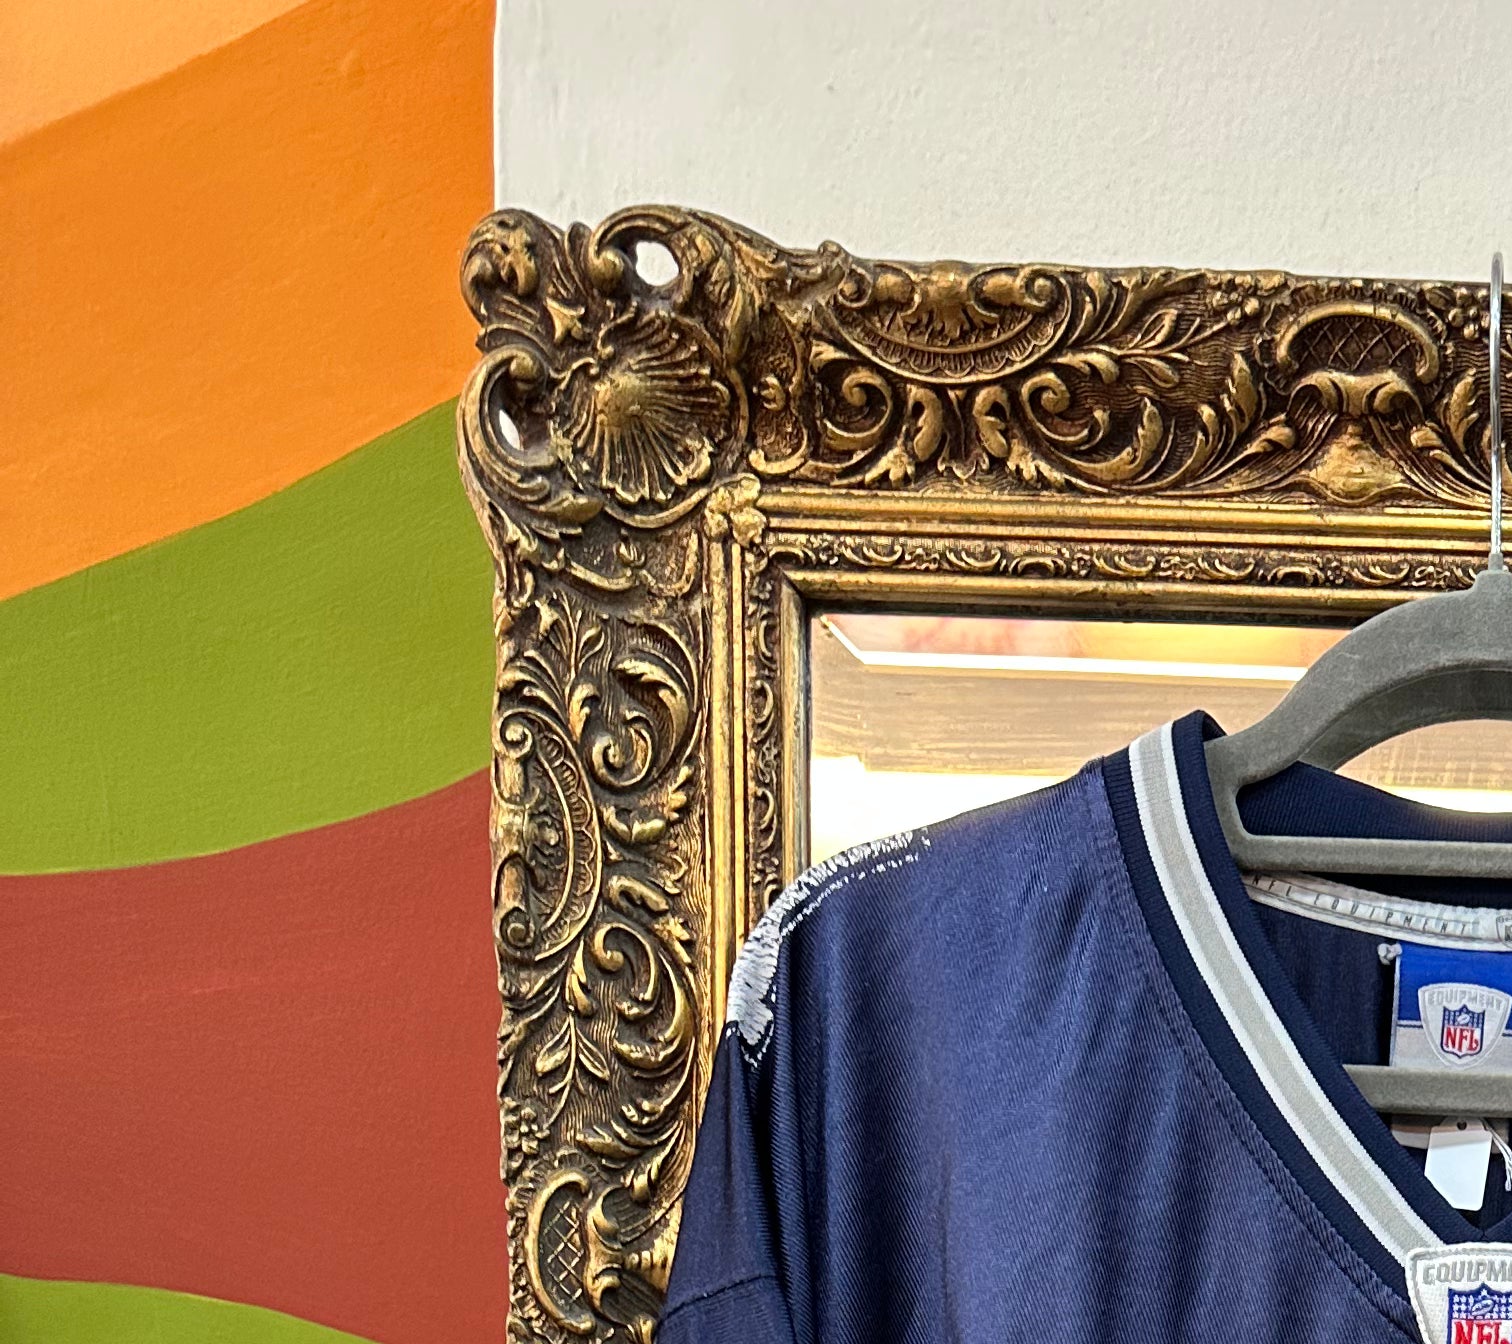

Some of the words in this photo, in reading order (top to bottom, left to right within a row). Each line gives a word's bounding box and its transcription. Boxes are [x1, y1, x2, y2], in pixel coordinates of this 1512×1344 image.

[1252, 876, 1292, 897] NFL
[1313, 894, 1467, 936] EQUIPMENT
[1427, 985, 1505, 1012] EQUIPMENT
[1445, 1026, 1479, 1053] NFL
